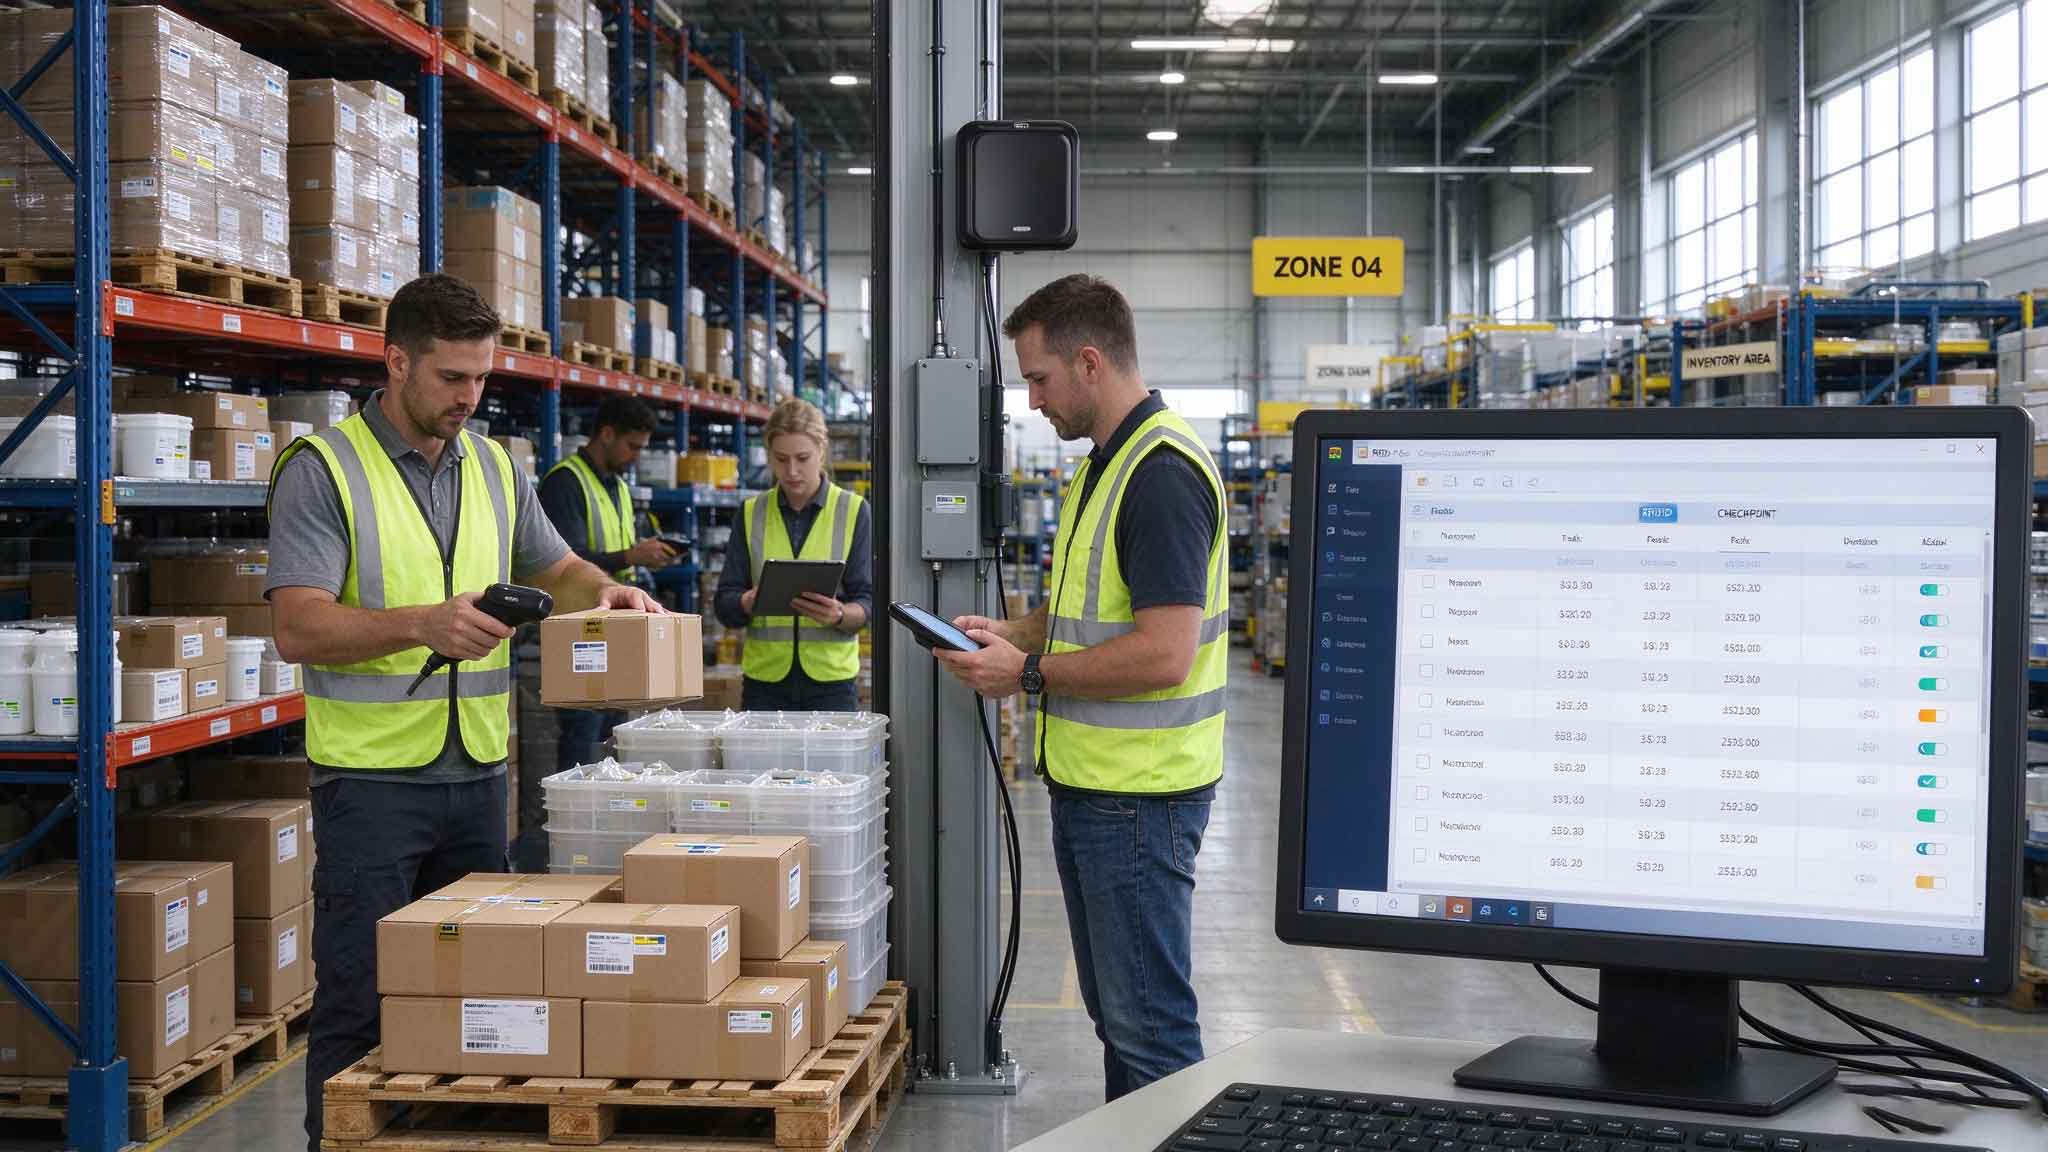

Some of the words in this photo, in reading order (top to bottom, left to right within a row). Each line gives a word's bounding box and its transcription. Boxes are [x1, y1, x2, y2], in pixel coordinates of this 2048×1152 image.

[1273, 256, 1343, 278] ZONE
[1351, 255, 1383, 278] 04
[1686, 354, 1741, 368] INVENTORY
[1743, 353, 1771, 365] AREA
